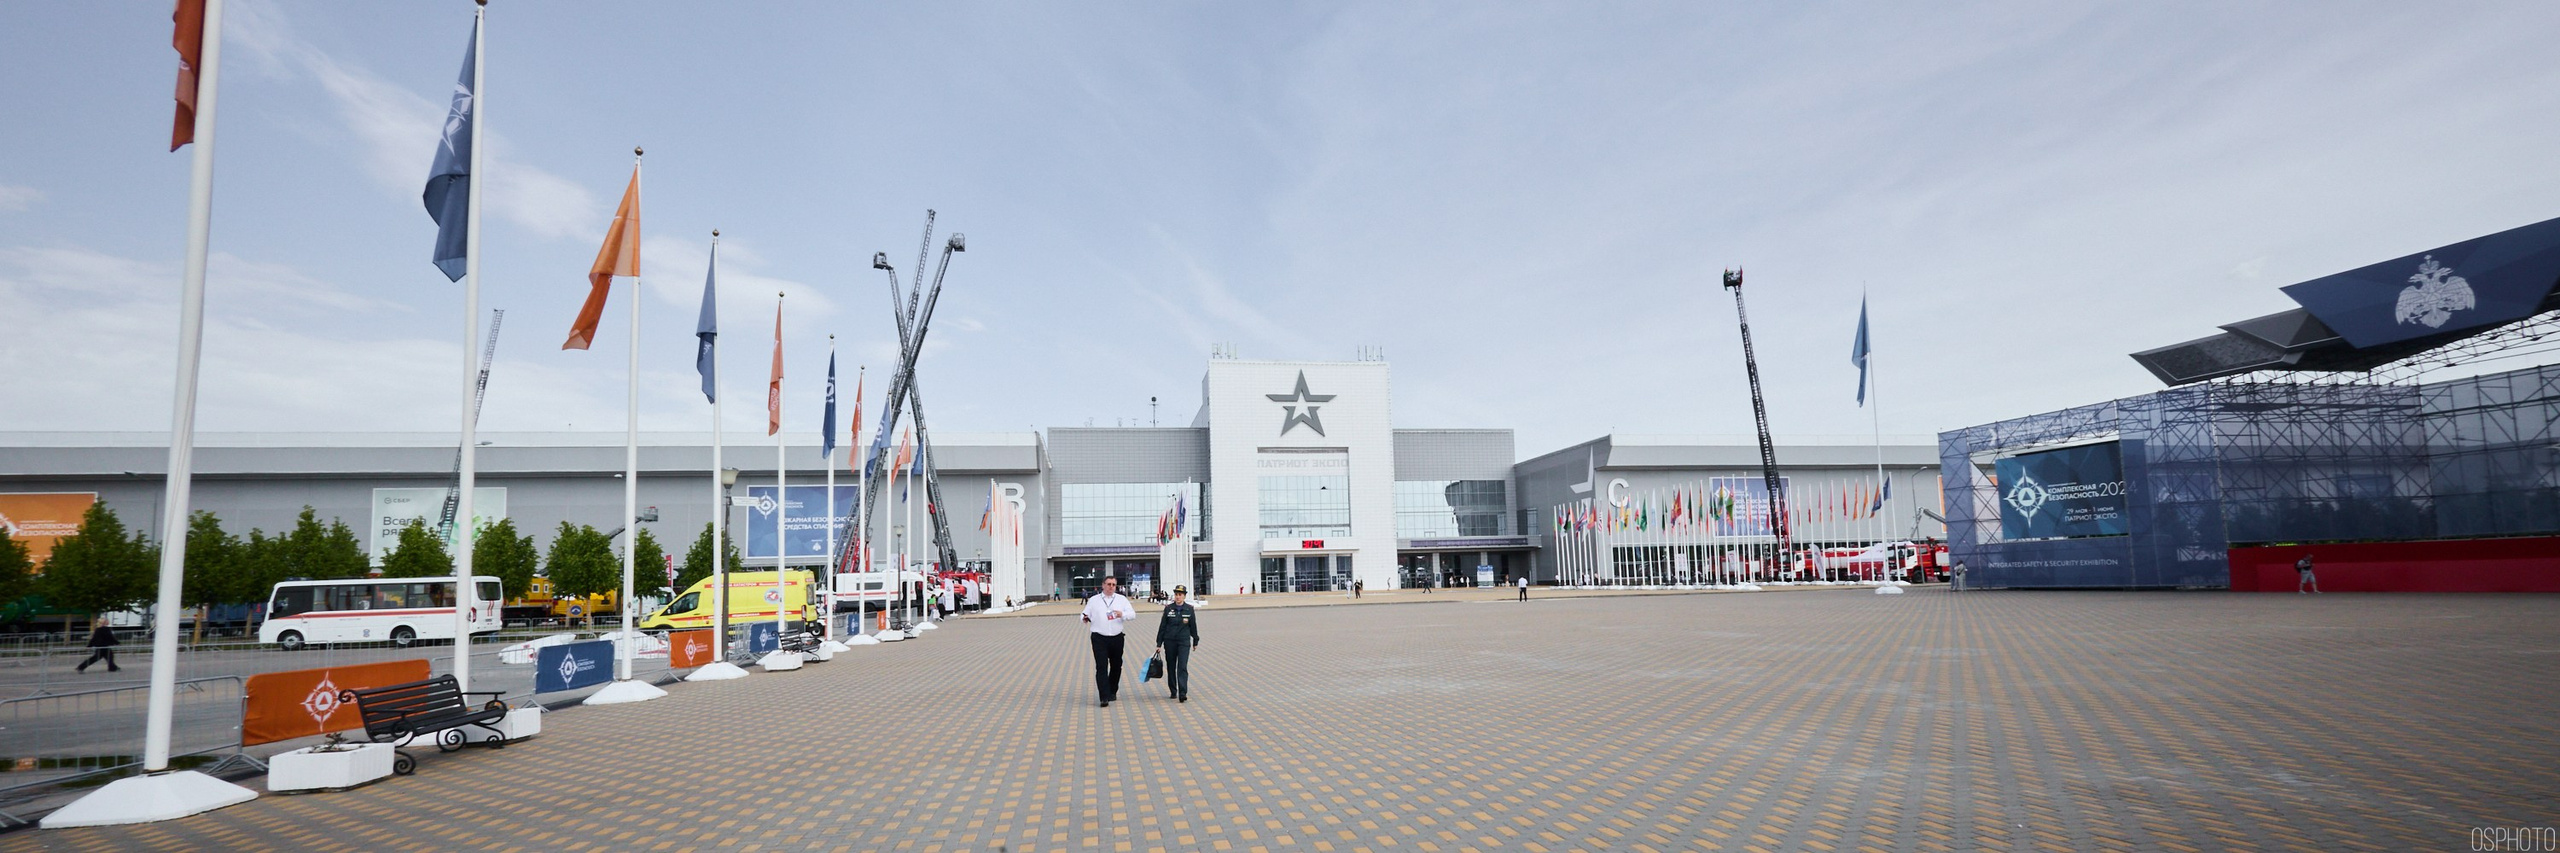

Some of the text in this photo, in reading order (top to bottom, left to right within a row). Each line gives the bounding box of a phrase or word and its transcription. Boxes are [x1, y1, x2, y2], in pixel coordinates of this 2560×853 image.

[1257, 459, 1348, 468] ПАТРИОТ ЭКСПО
[1607, 478, 1629, 508] C
[2048, 480, 2138, 497] КОМПЛЕКСНАЯ 2024
[2048, 491, 2100, 501] БЕЗОПАСНОСТЬ
[383, 516, 427, 526] Всега
[2080, 558, 2118, 566] EXHIBITION
